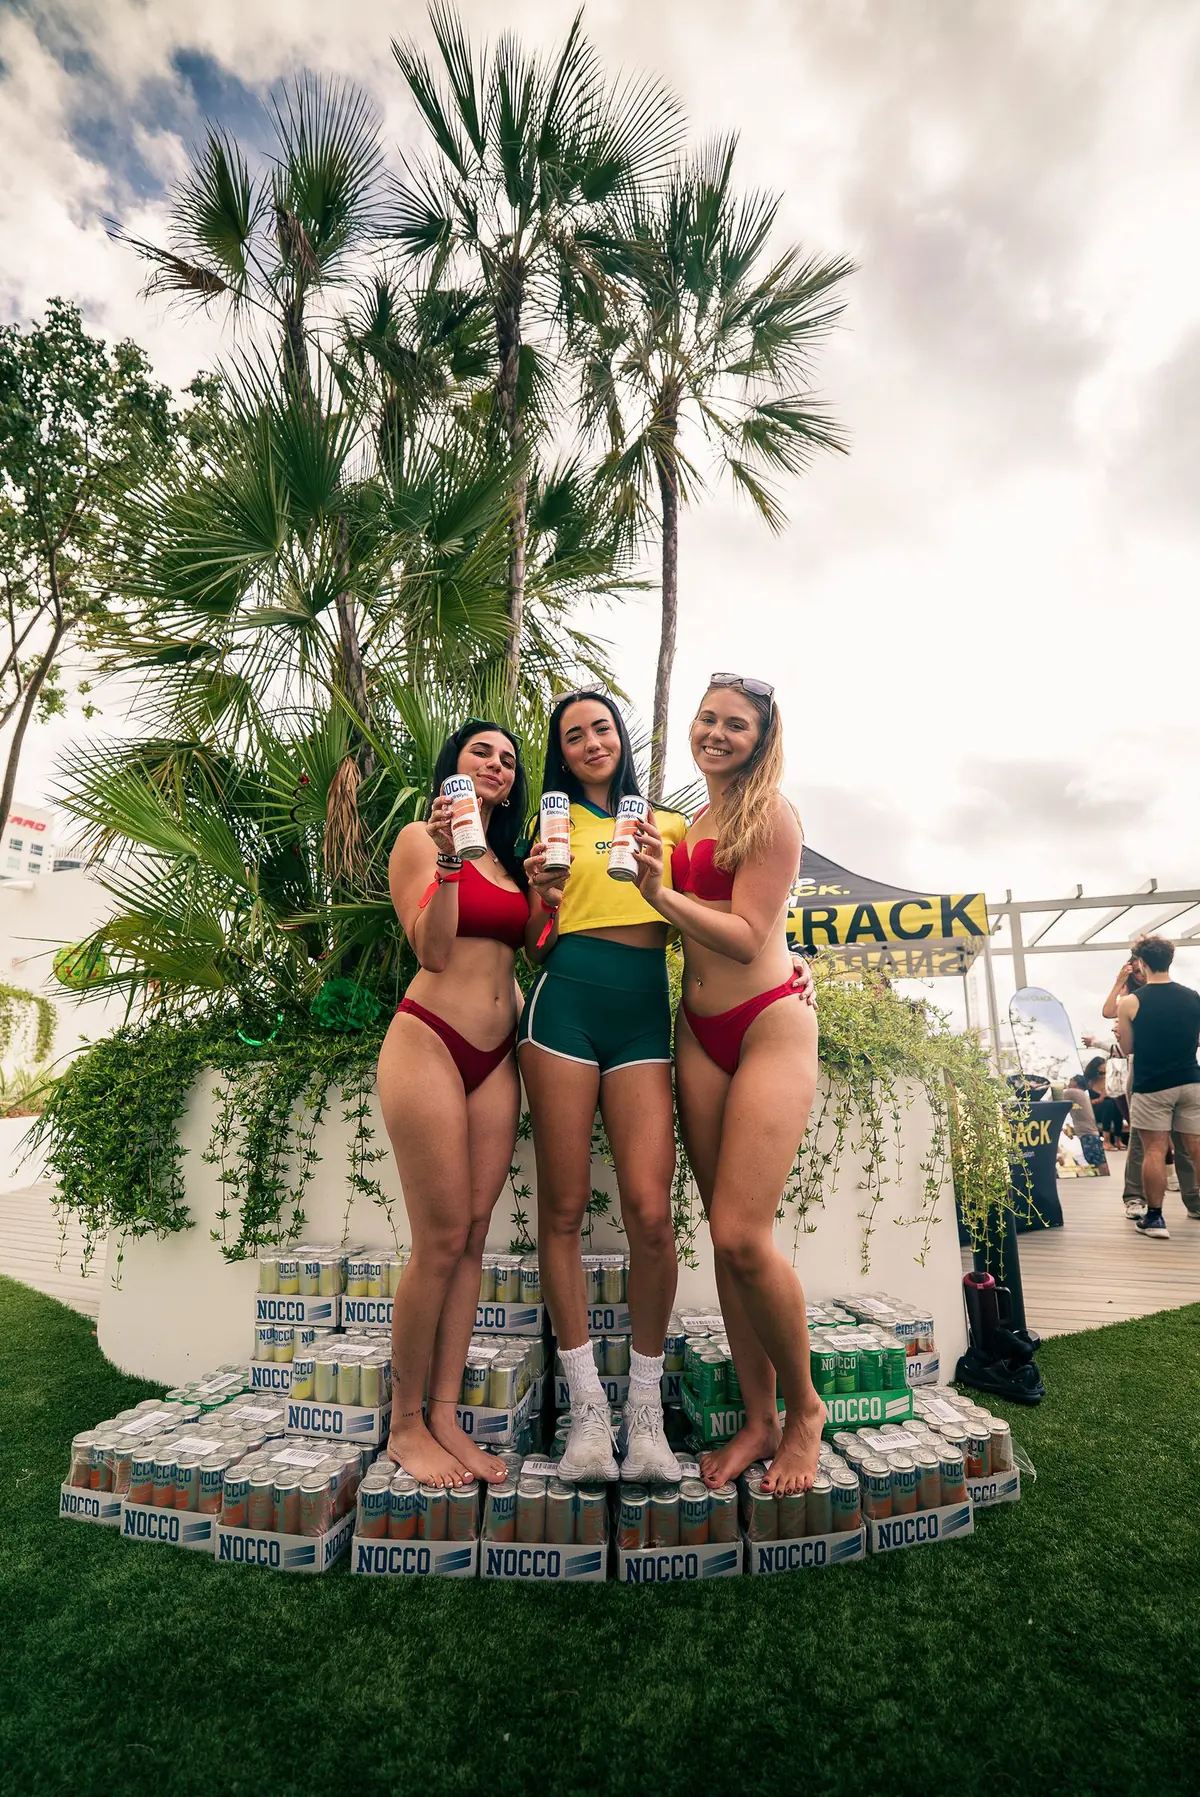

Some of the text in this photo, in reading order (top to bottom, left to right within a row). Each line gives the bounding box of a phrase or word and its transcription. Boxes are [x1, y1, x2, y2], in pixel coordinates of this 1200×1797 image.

[786, 894, 985, 945] RACK
[257, 1299, 304, 1321] NOCCO
[474, 1307, 505, 1328] CCO
[251, 1367, 293, 1389] NOCC
[288, 1405, 343, 1434] NOCCO
[825, 1397, 881, 1424] NOCCO
[61, 1493, 100, 1518] NOCCO
[967, 1483, 996, 1502] OCCO
[124, 1510, 179, 1542] NOCCO
[878, 1514, 938, 1549] NOCCO
[219, 1534, 280, 1567] NOCCO
[357, 1545, 430, 1574] NOCCO
[486, 1548, 560, 1577] NOCCO
[758, 1540, 826, 1573] NOCCO
[625, 1553, 698, 1584] NOCCO
